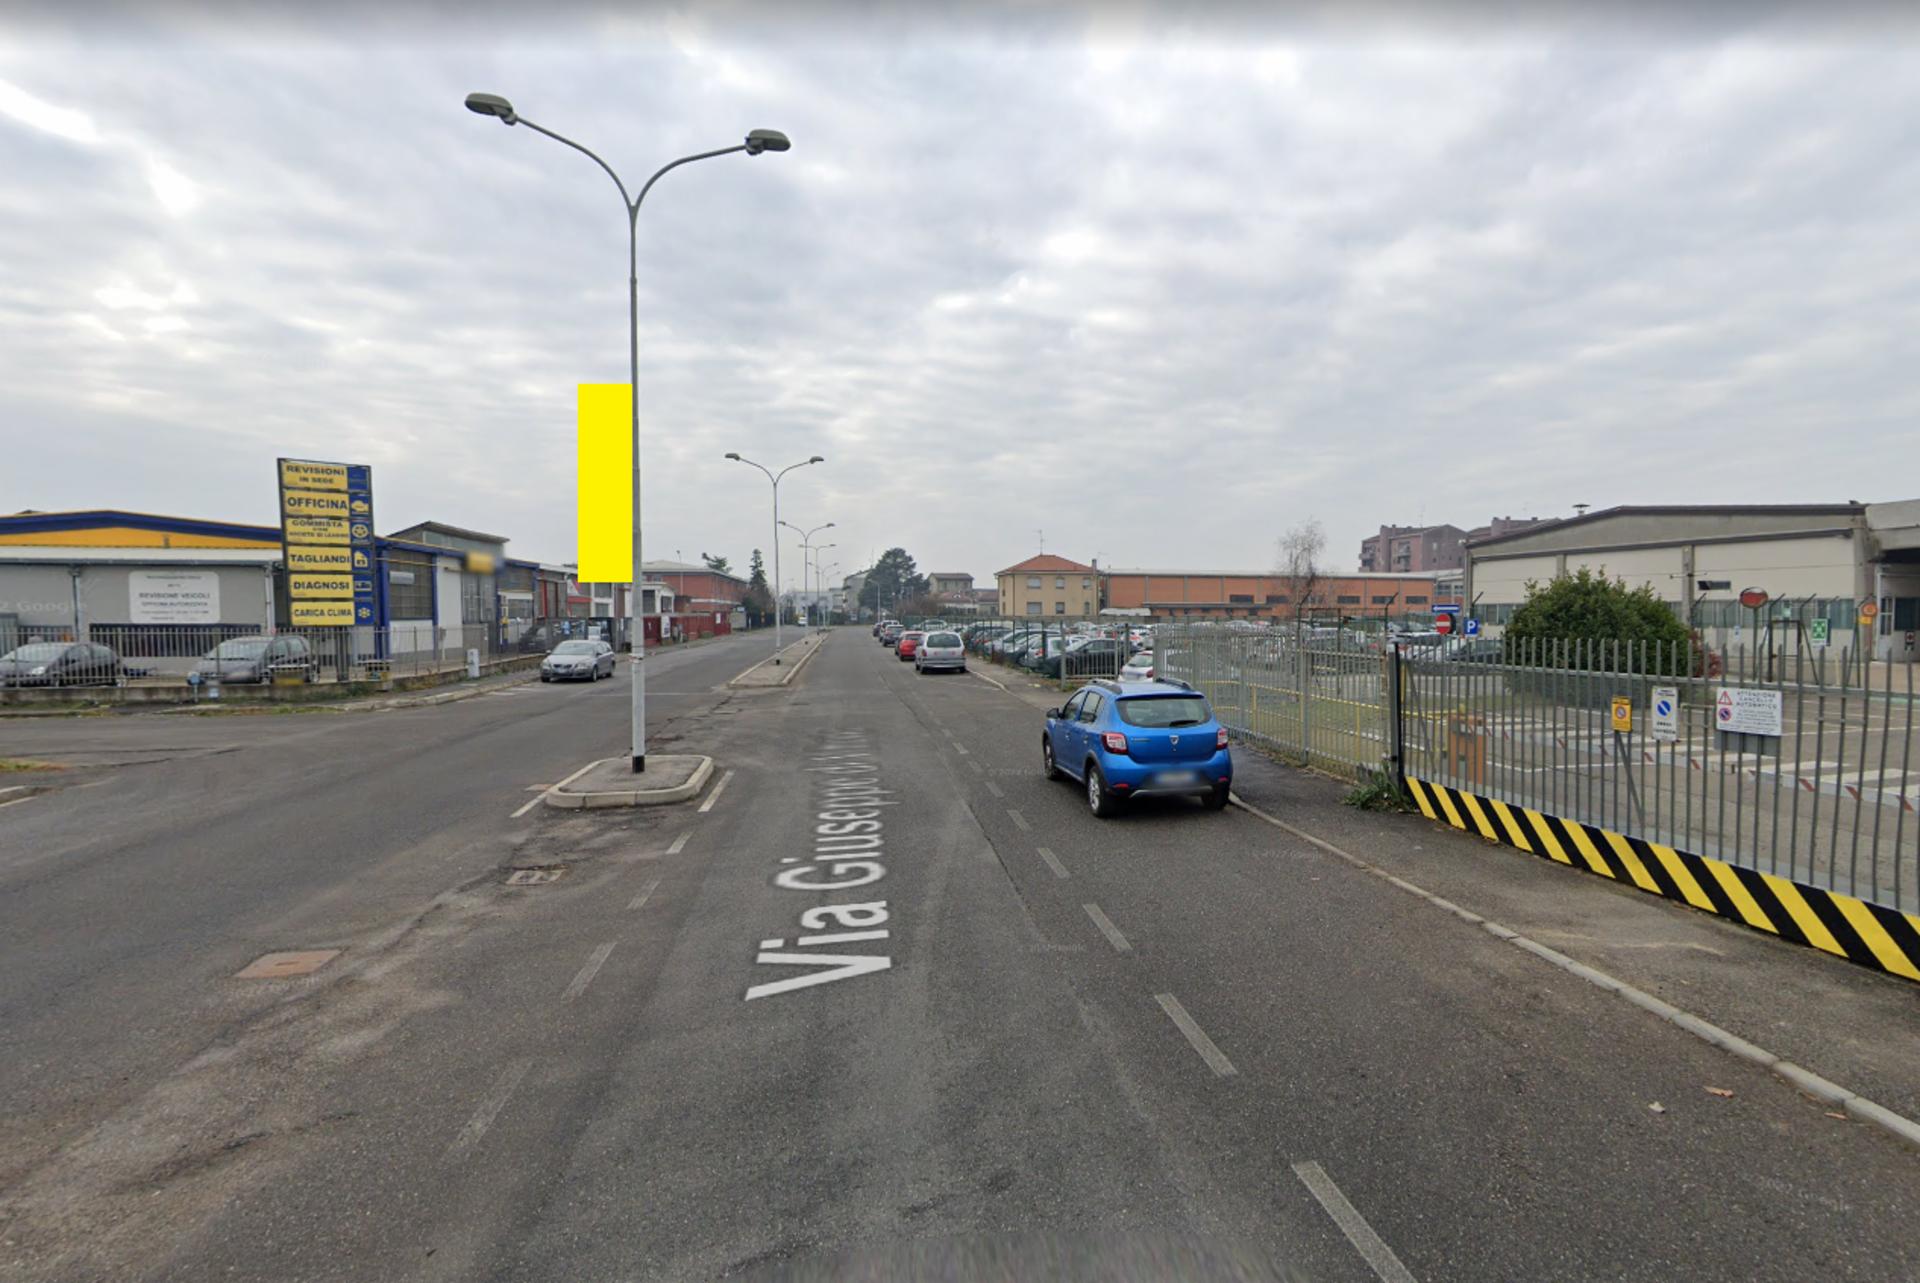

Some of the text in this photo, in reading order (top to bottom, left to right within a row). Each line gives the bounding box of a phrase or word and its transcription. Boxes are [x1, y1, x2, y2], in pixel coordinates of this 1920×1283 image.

[286, 464, 345, 476] REVISIONI
[287, 497, 348, 510] OFFICINA
[290, 554, 351, 564] TAGLIANDI
[293, 581, 350, 591] DIAGNOSI
[294, 608, 353, 617] CARICA CLIMA
[1467, 620, 1476, 633] P
